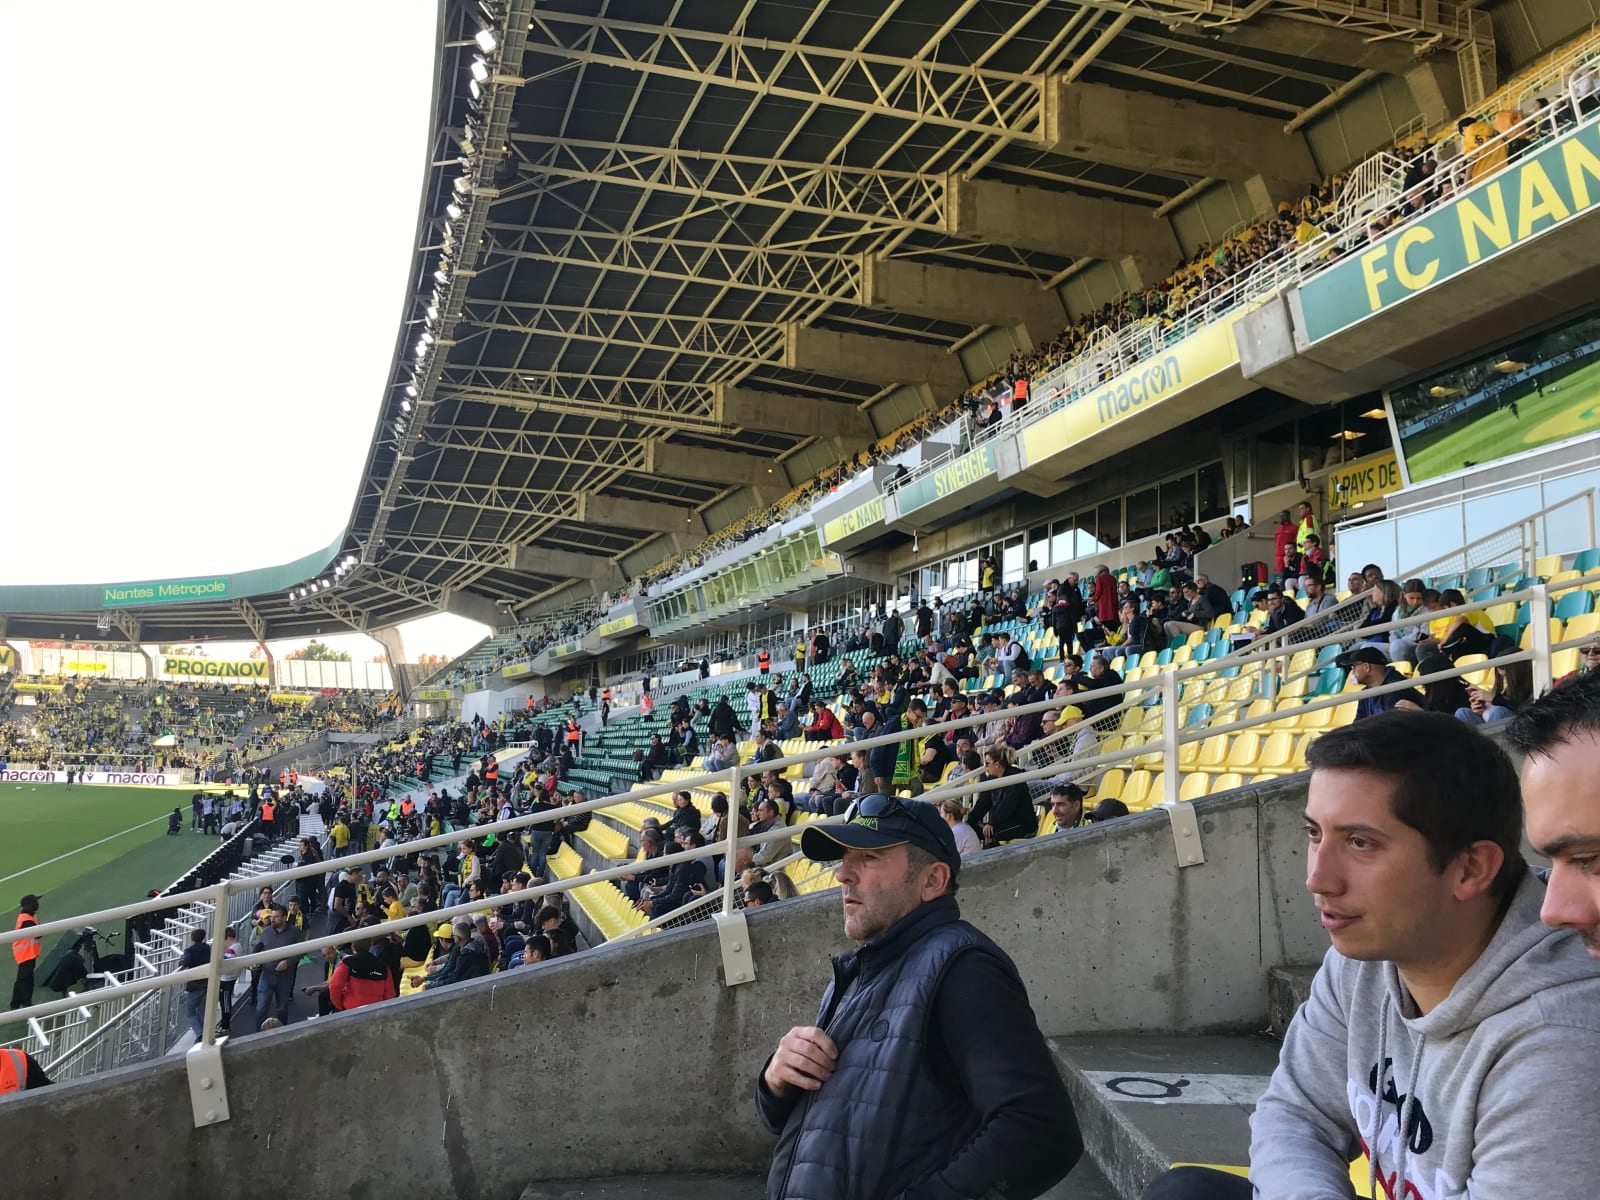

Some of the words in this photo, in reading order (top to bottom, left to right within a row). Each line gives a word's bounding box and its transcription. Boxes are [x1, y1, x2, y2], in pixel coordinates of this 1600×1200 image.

[1361, 226, 1440, 312] FC
[1097, 355, 1182, 423] macron
[934, 446, 991, 497] SYNERGIE
[1343, 467, 1375, 500] PAYS
[1378, 461, 1397, 489] DE
[842, 514, 855, 535] FC
[105, 588, 154, 601] Nantes
[159, 581, 225, 596] Métropole
[107, 773, 165, 785] macron
[1106, 1077, 1191, 1099] Q
